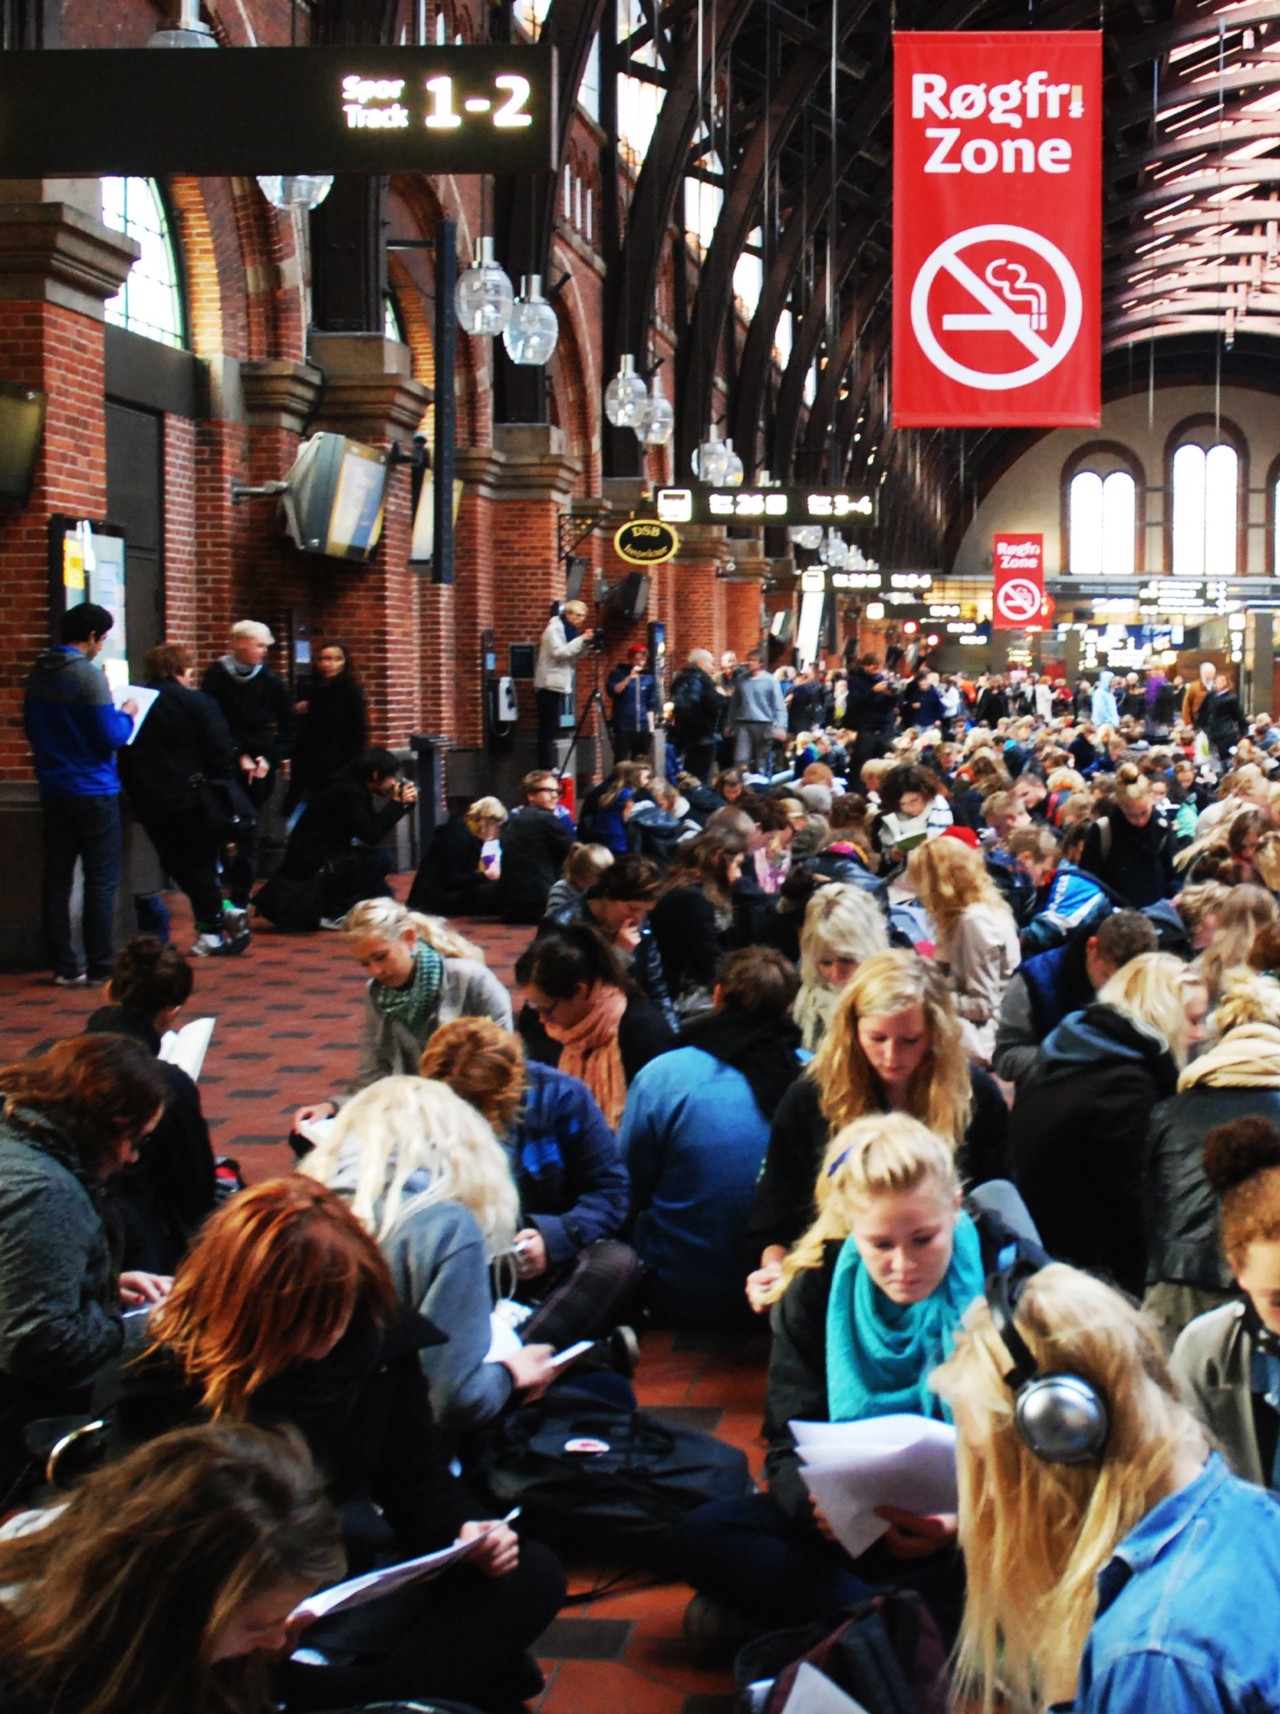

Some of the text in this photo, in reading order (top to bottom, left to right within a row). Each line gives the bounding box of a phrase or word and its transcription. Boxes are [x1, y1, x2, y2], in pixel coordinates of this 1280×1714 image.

[425, 75, 532, 128] 1-2
[342, 103, 409, 128] Track
[924, 127, 1073, 174] Zone
[632, 525, 660, 537] DSB
[1000, 555, 1039, 569] Zone
